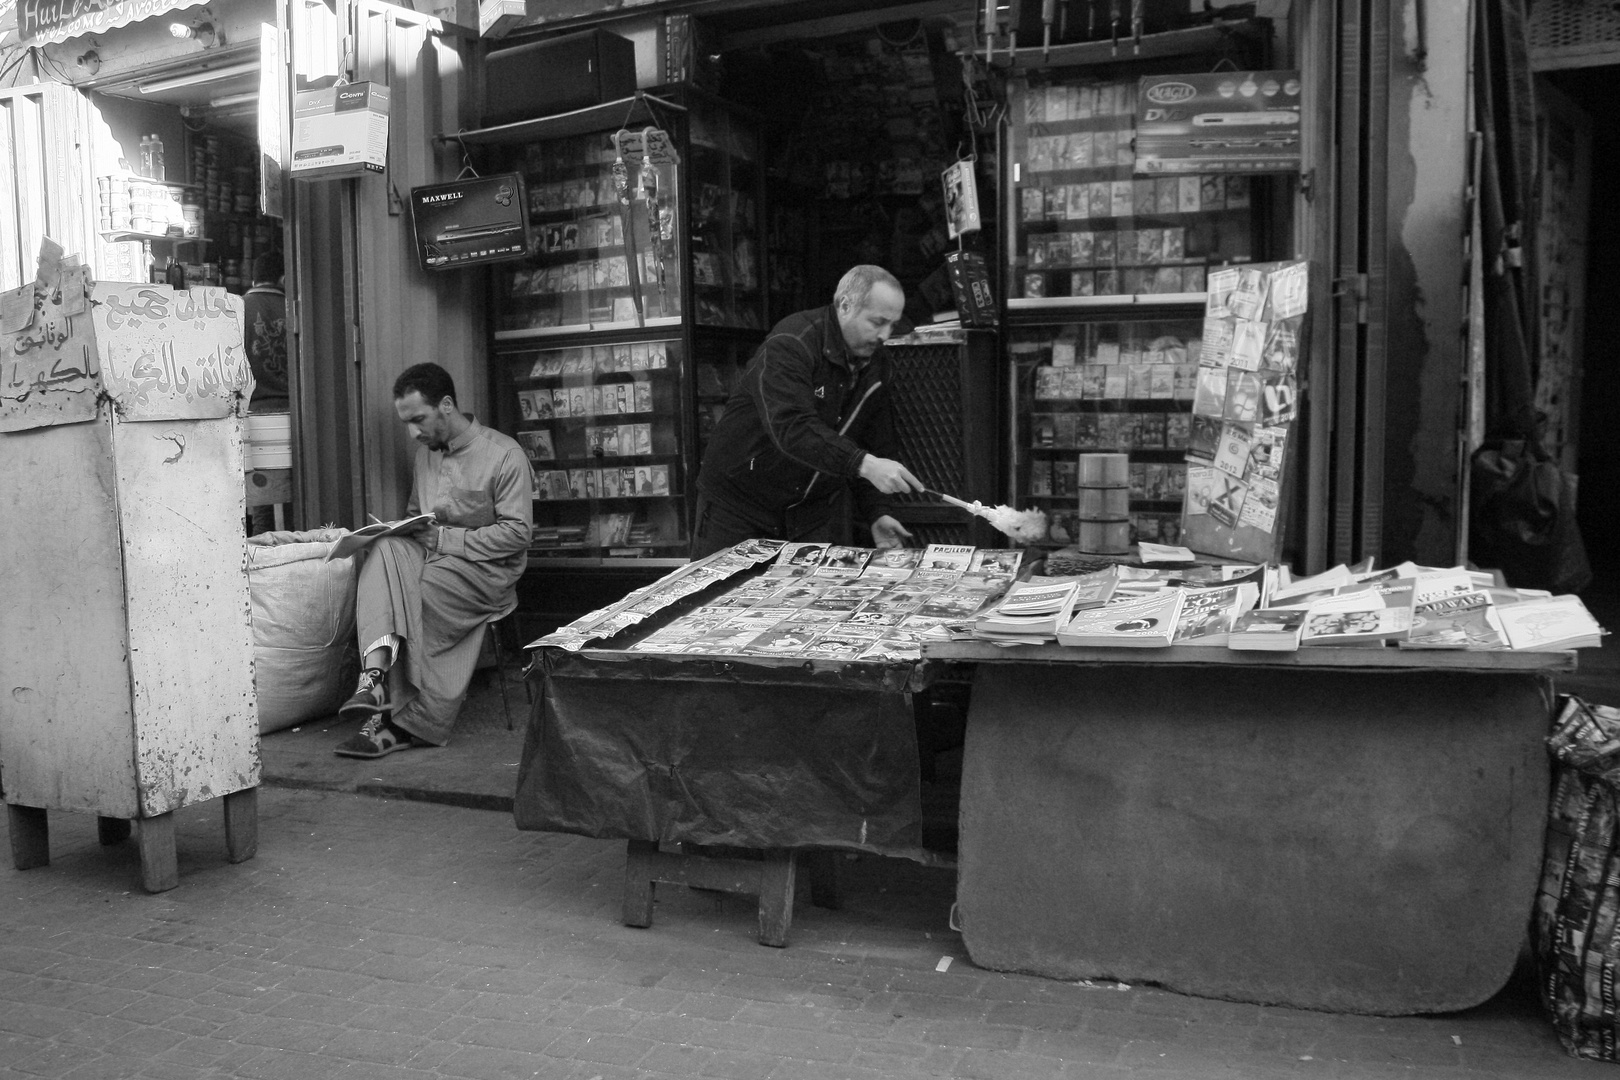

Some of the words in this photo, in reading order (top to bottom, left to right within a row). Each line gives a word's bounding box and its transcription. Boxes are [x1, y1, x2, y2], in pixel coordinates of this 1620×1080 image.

[422, 191, 464, 204] MAXWELL
[105, 289, 170, 331] جميع
[1220, 460, 1238, 474] 2012
[933, 546, 972, 554] PAPILLON
[1554, 914, 1565, 955] PARIS
[1603, 961, 1616, 1015] FLORIDA
